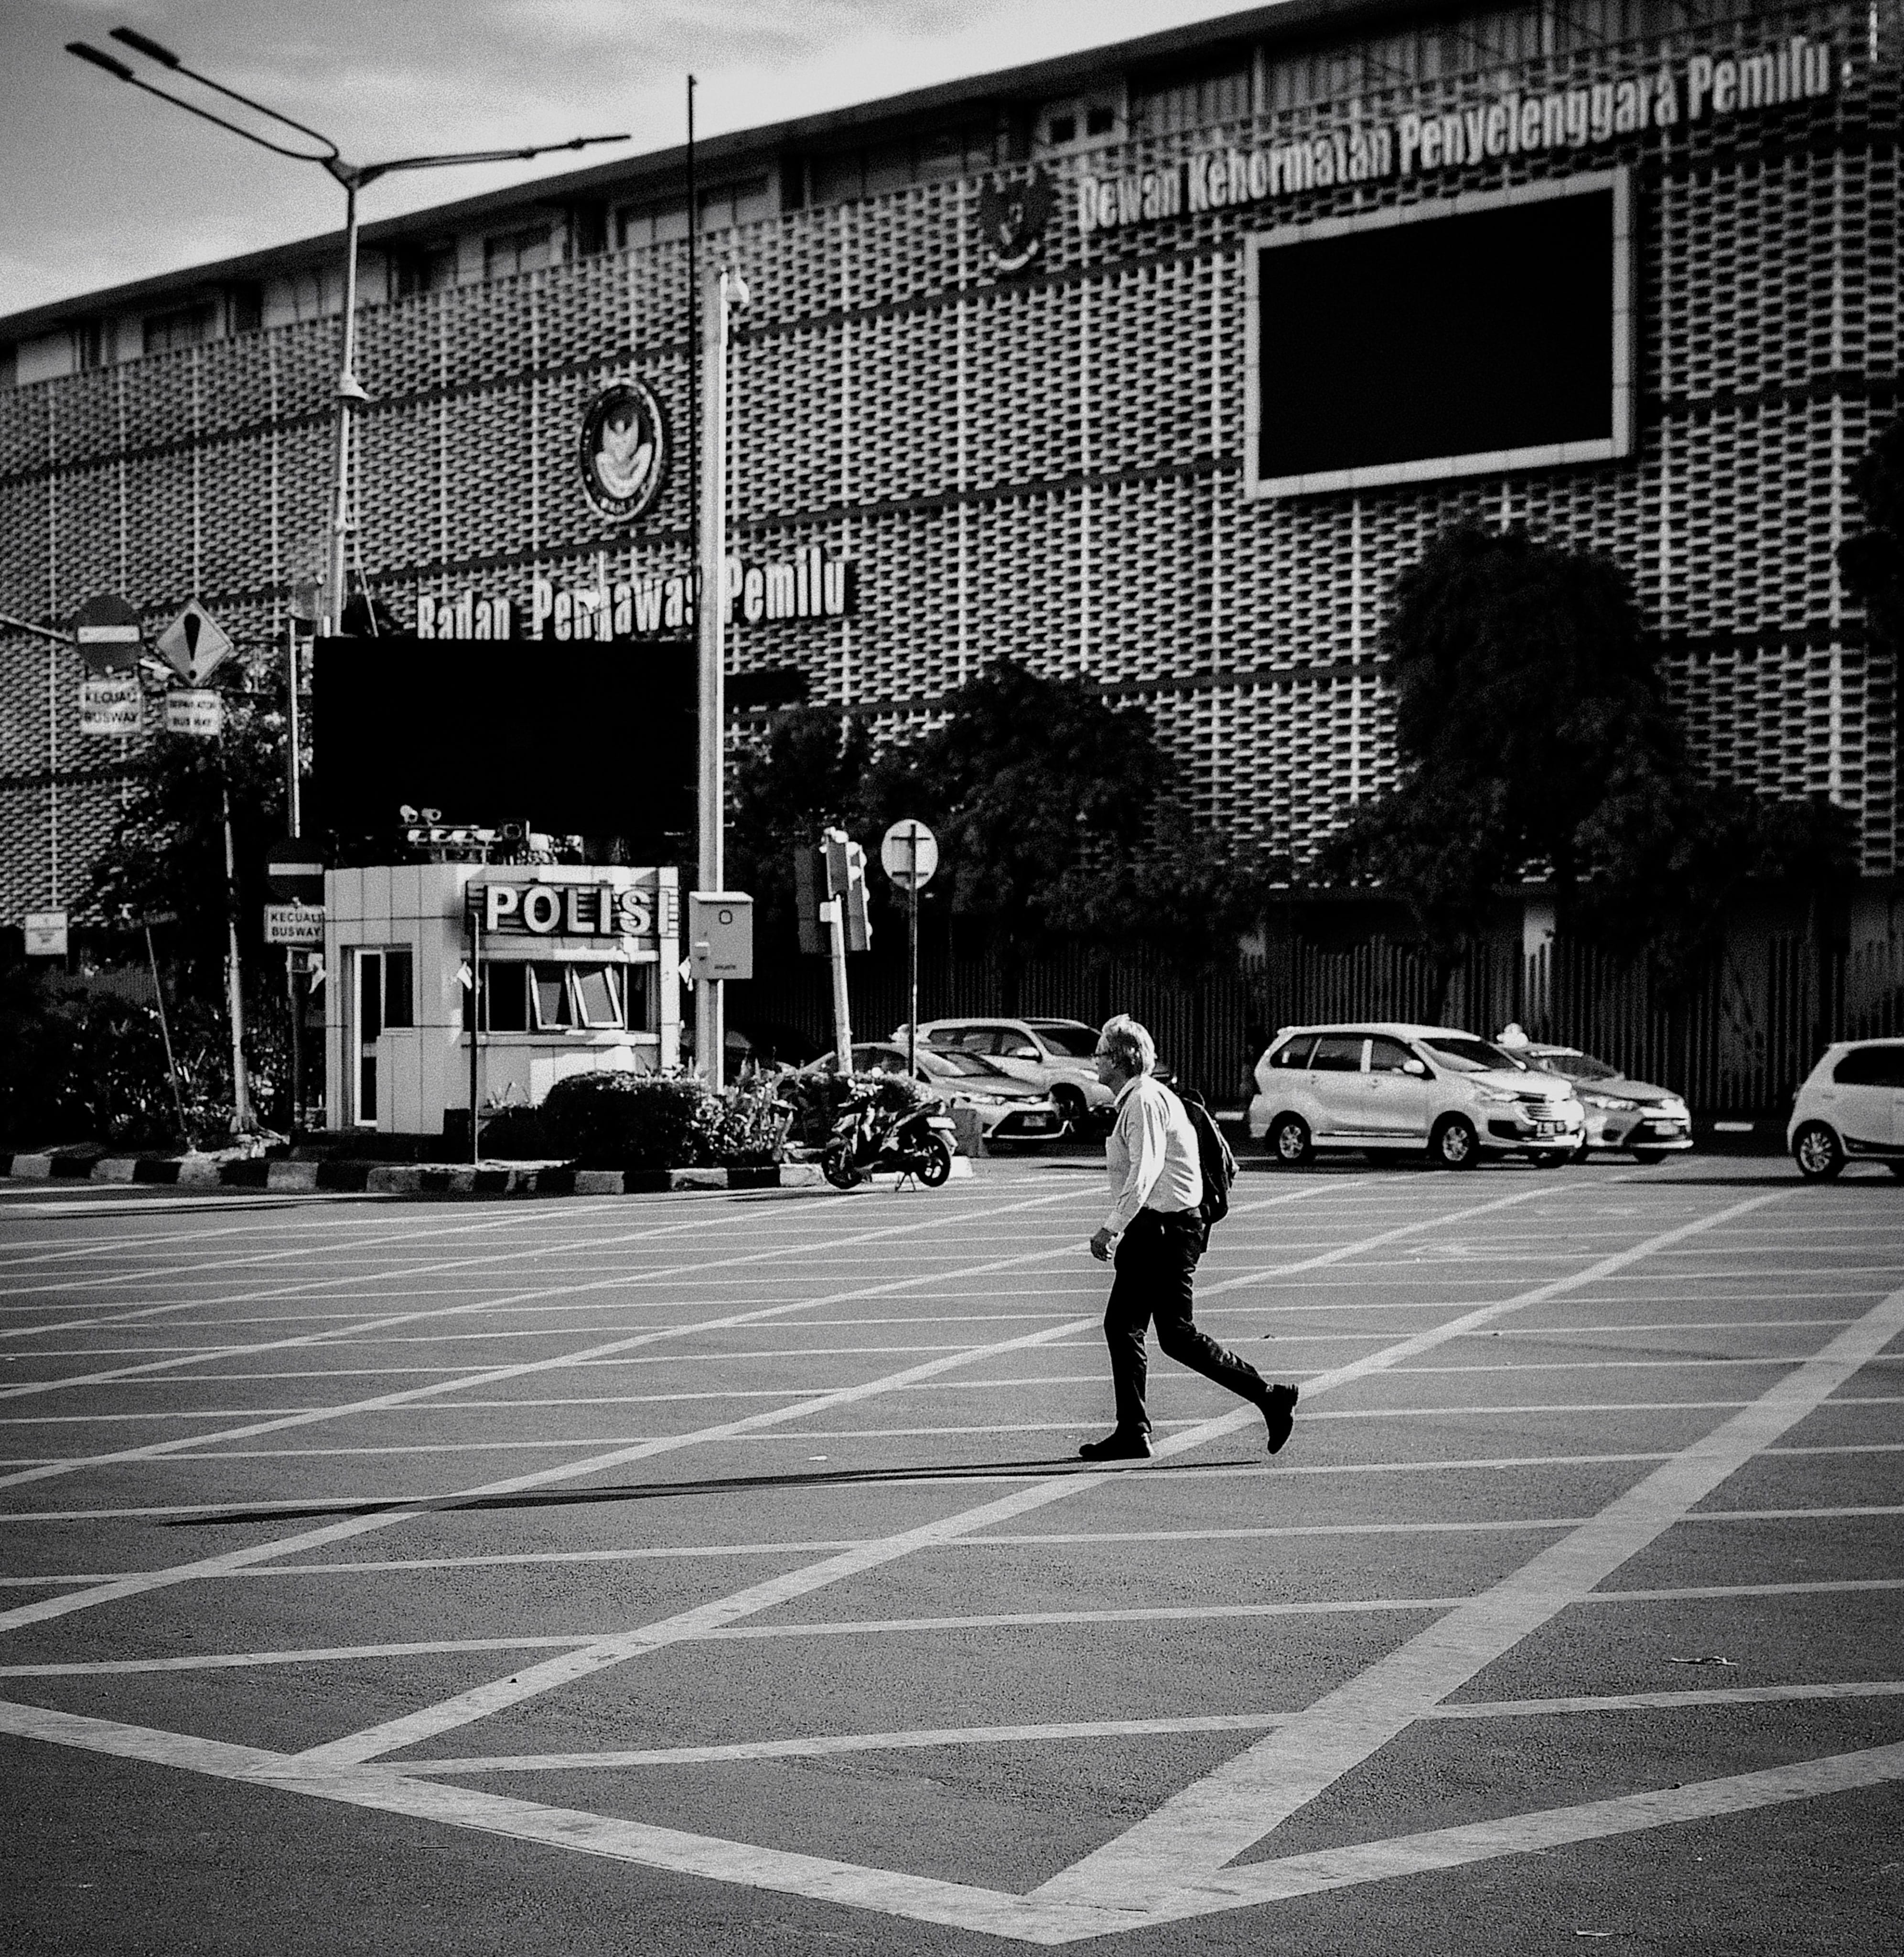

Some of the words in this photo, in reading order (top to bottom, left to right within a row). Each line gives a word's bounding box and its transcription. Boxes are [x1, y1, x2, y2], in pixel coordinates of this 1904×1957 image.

[1078, 170, 1180, 231] Dewan
[1188, 127, 1391, 212] Kehormatan
[1399, 69, 1678, 175] Penyelenggara
[1688, 36, 1829, 119] Pemilu
[724, 546, 845, 624] Pemilu
[272, 927, 322, 936] BUSWAY
